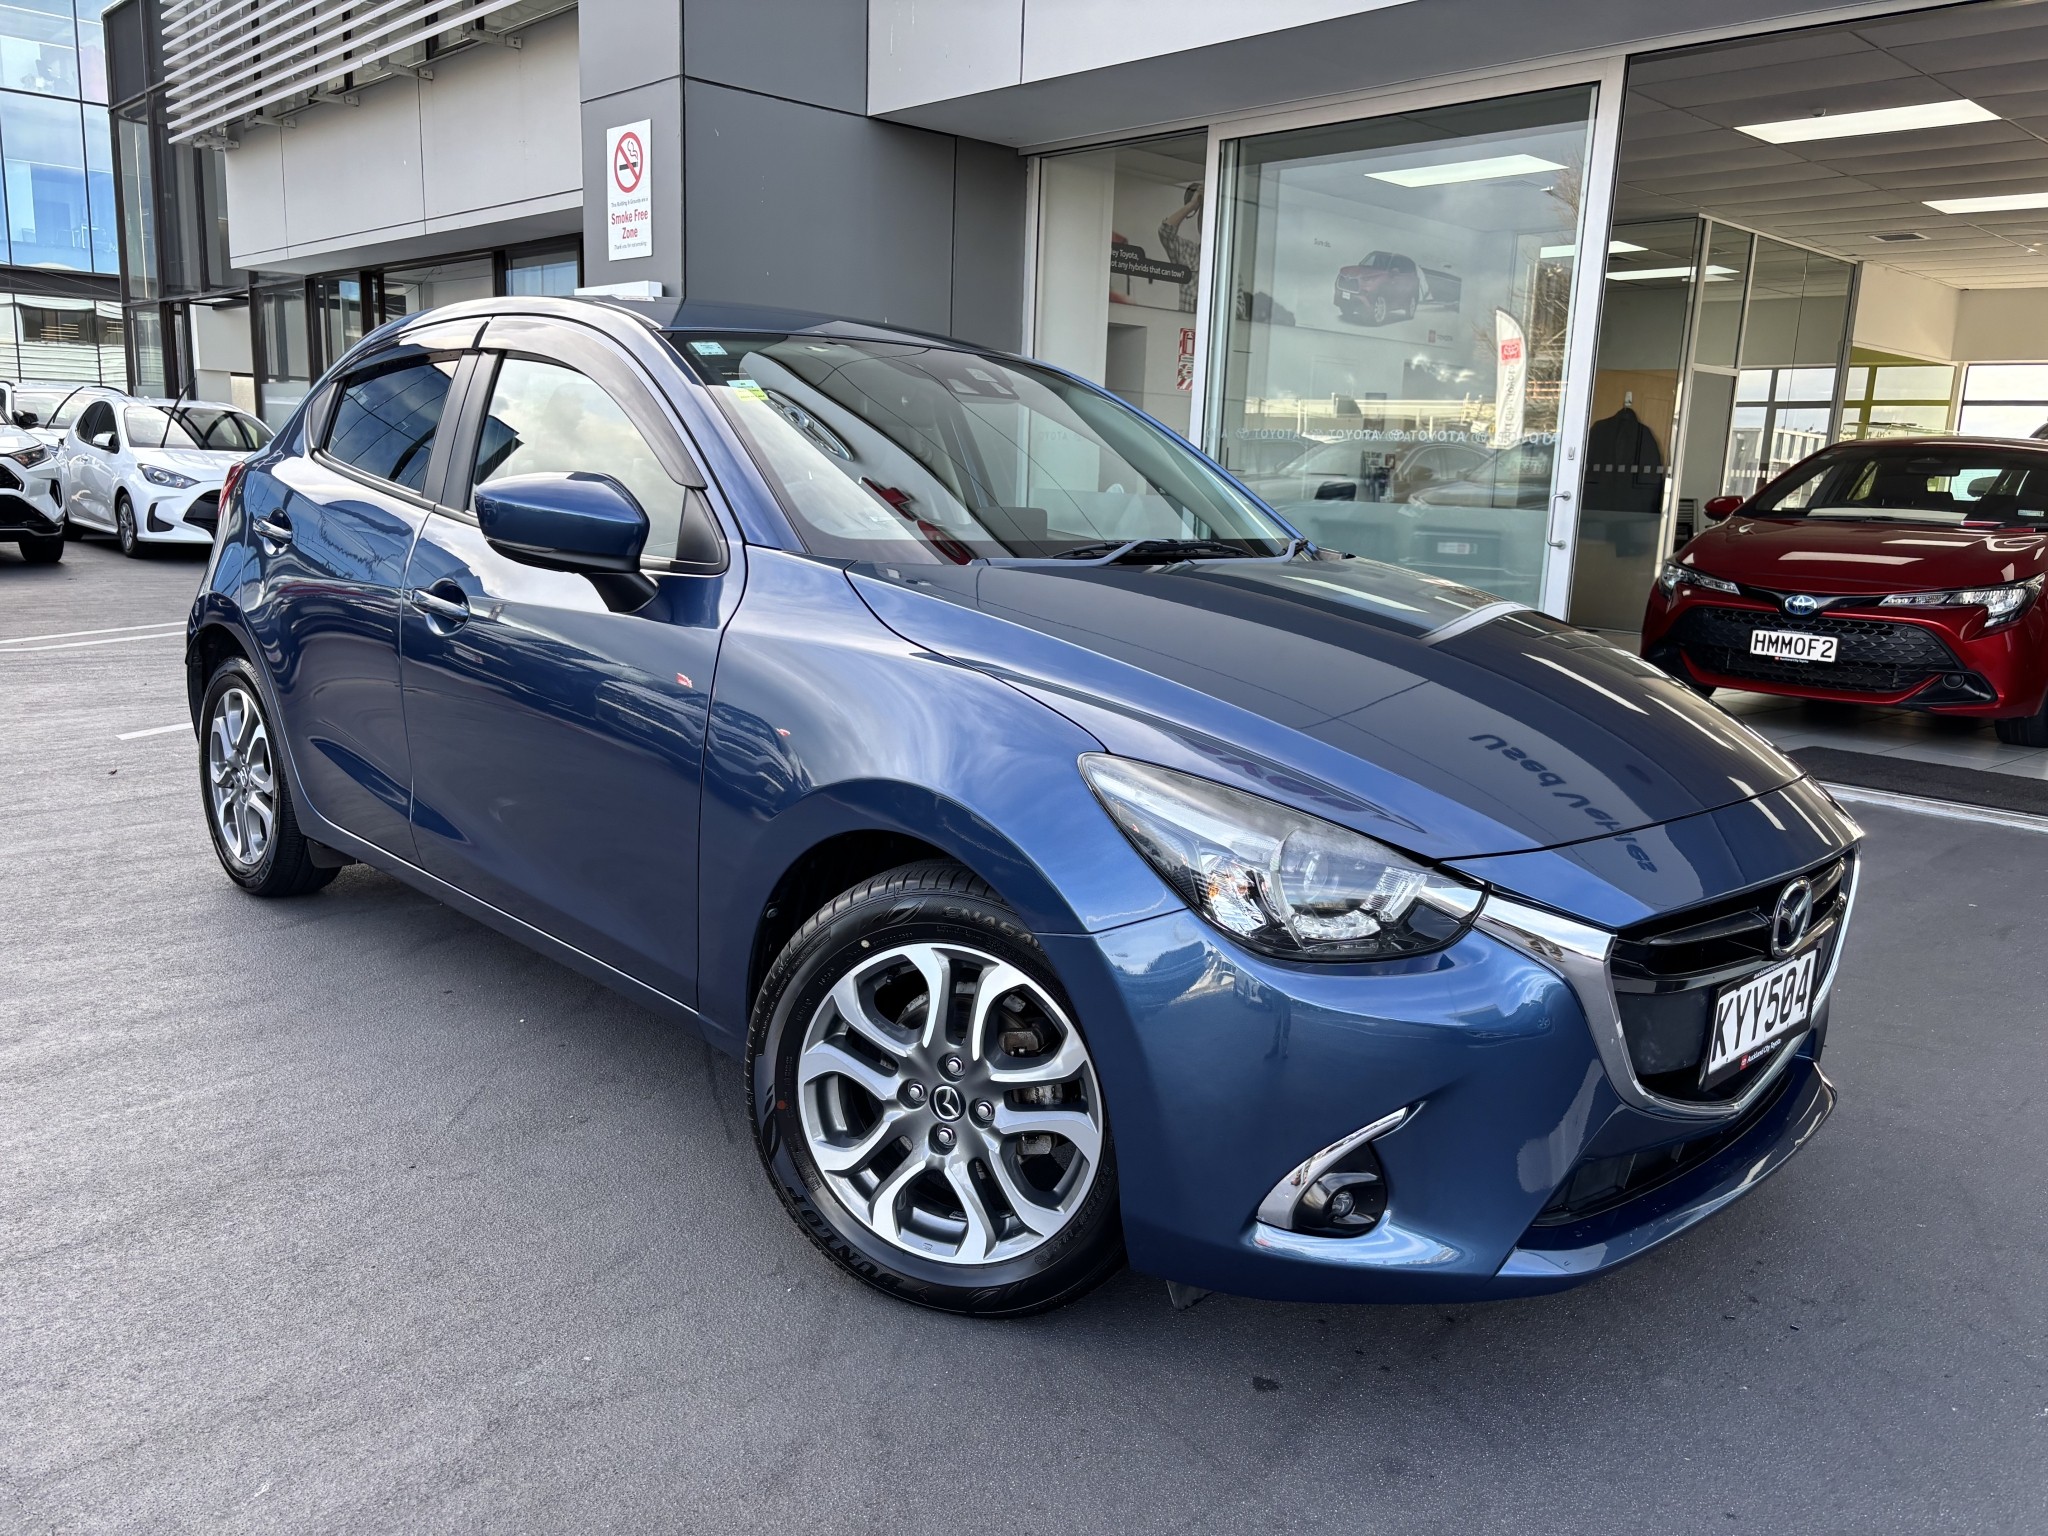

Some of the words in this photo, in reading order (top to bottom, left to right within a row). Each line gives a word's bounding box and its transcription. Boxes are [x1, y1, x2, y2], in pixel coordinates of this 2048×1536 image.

[611, 210, 633, 225] Smoke
[634, 208, 649, 222] Free
[621, 226, 639, 240] Zone
[1118, 262, 1128, 271] any
[1128, 261, 1149, 273] hybrids
[1149, 265, 1161, 275] that
[1171, 269, 1185, 279] tow?
[1253, 428, 1300, 440] TOYOTA
[1328, 429, 1379, 441] TOYOTA
[1410, 430, 1467, 443] TOYOTA
[1710, 956, 1812, 1064] KYY504
